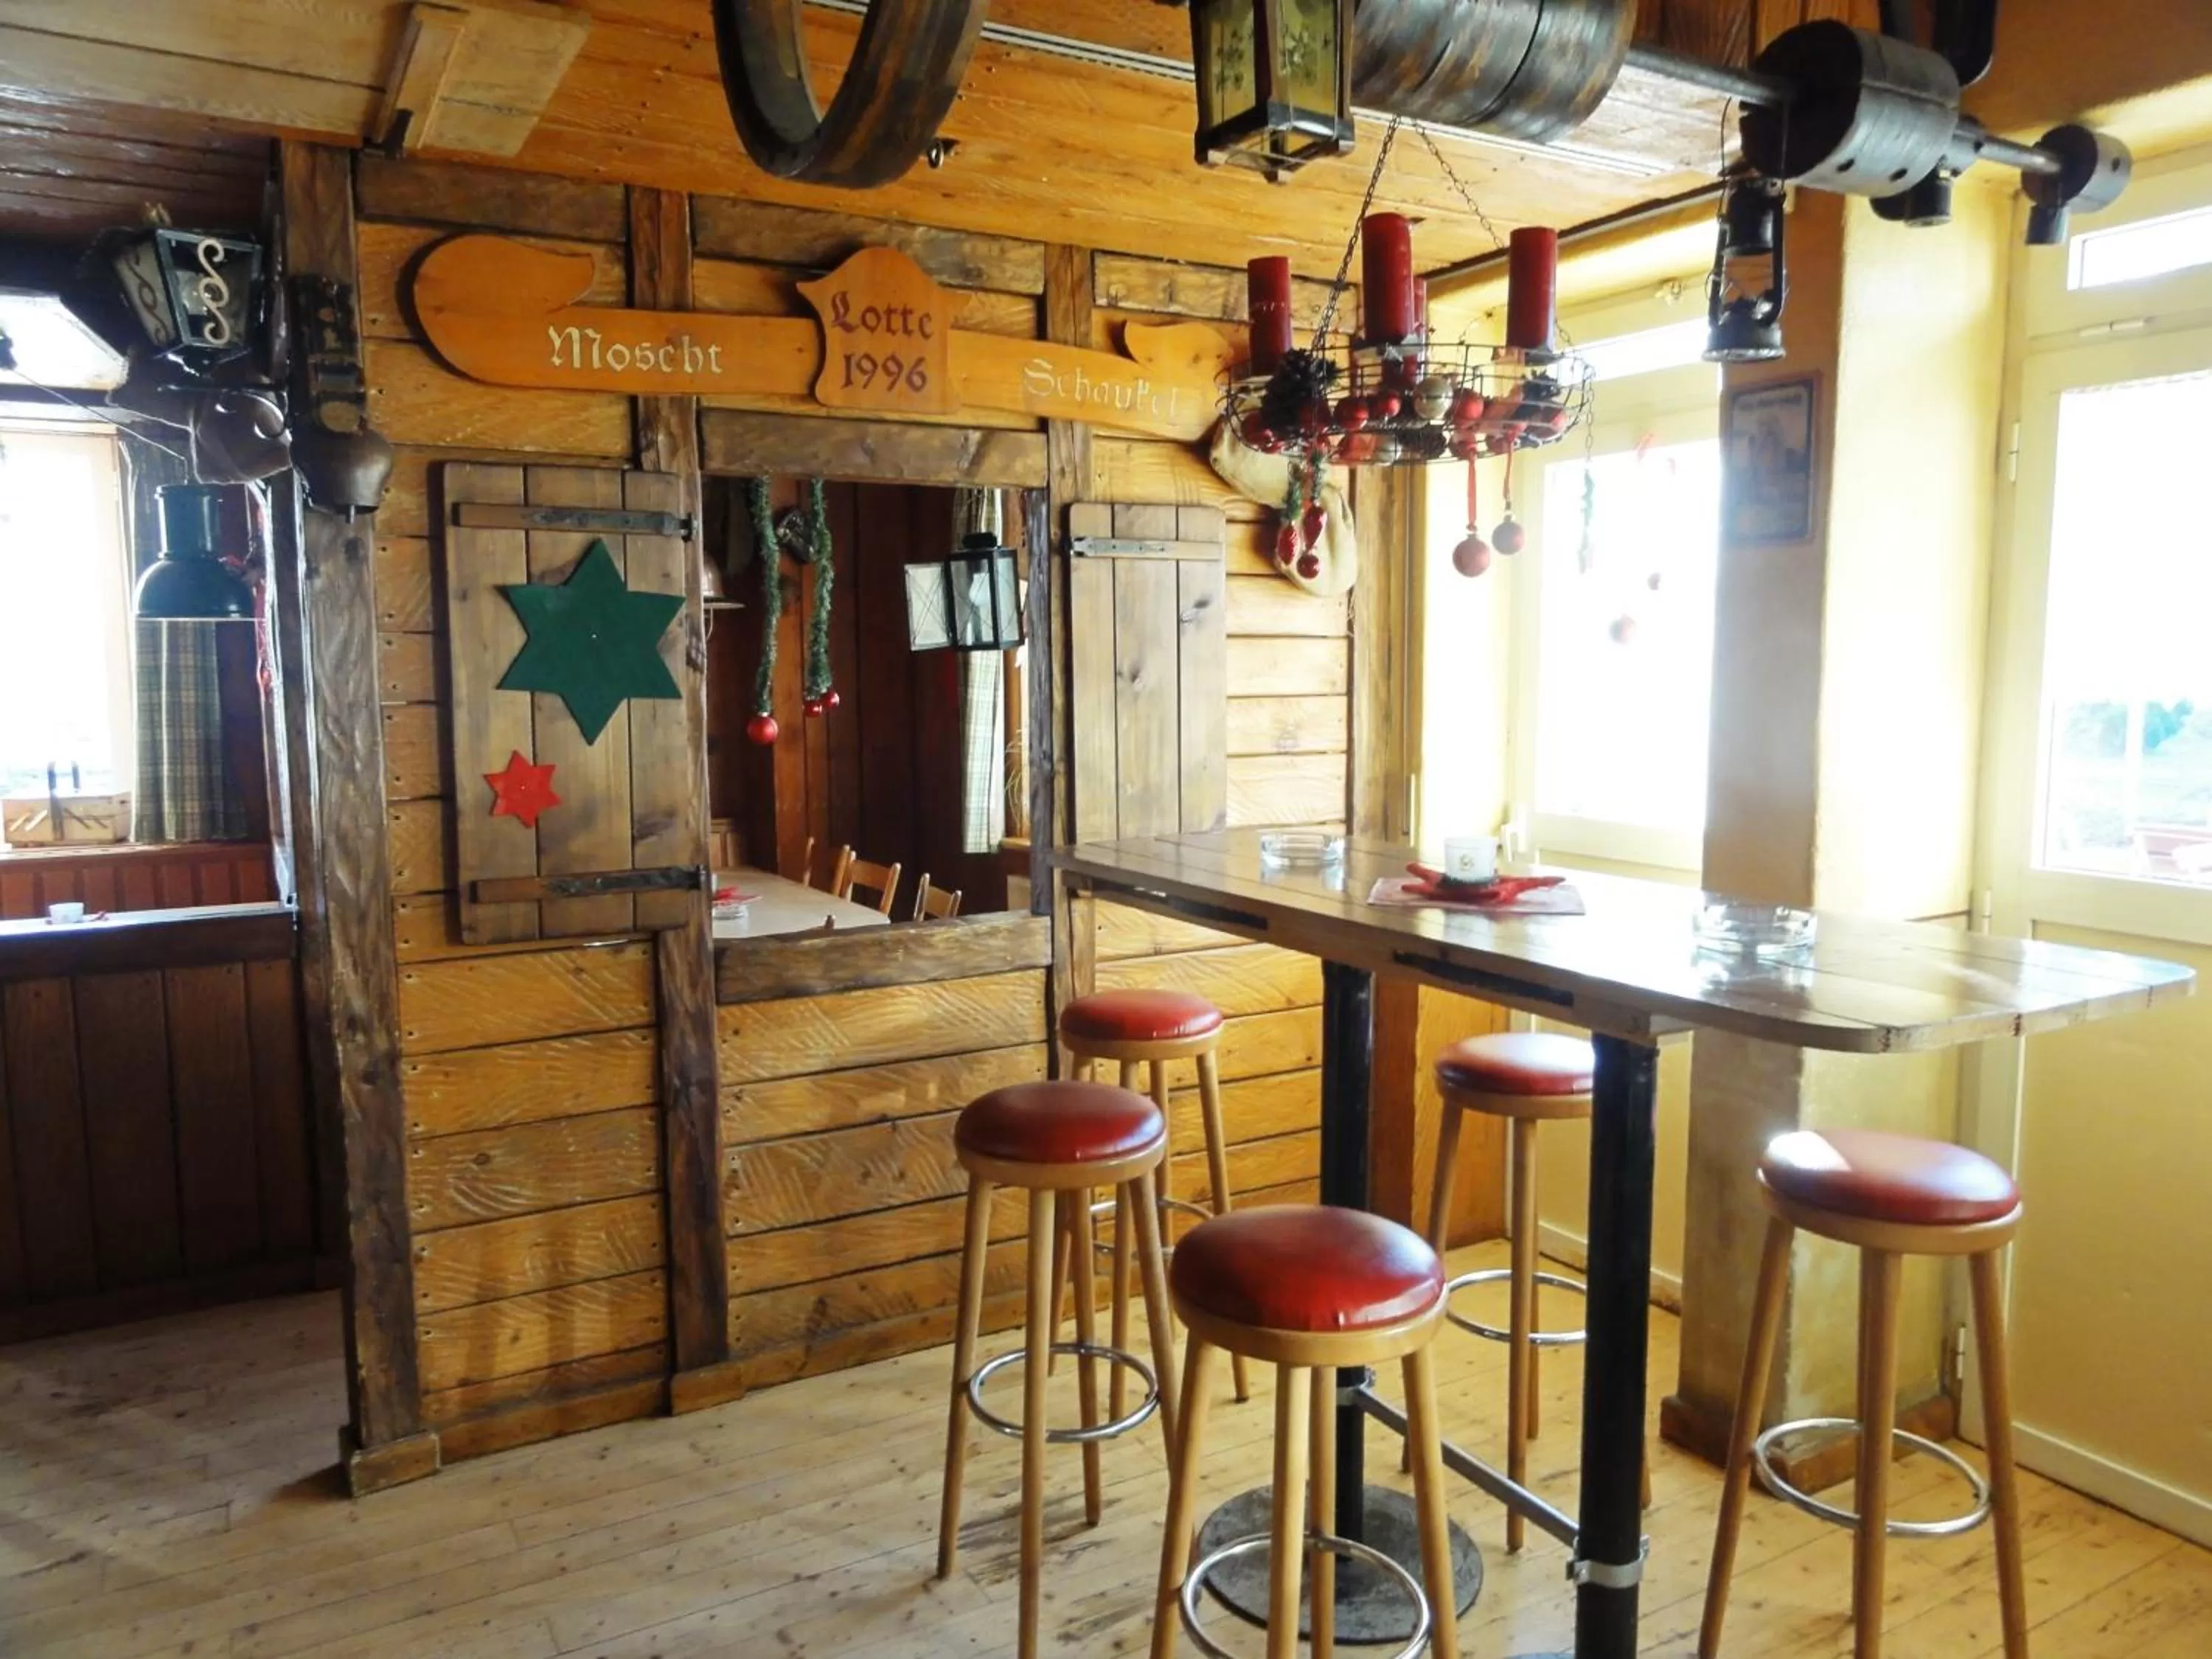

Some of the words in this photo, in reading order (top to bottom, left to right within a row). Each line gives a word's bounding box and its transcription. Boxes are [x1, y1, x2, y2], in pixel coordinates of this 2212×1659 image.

[831, 291, 934, 341] Lotte
[548, 325, 723, 374] Moscht
[841, 352, 928, 392] 1996
